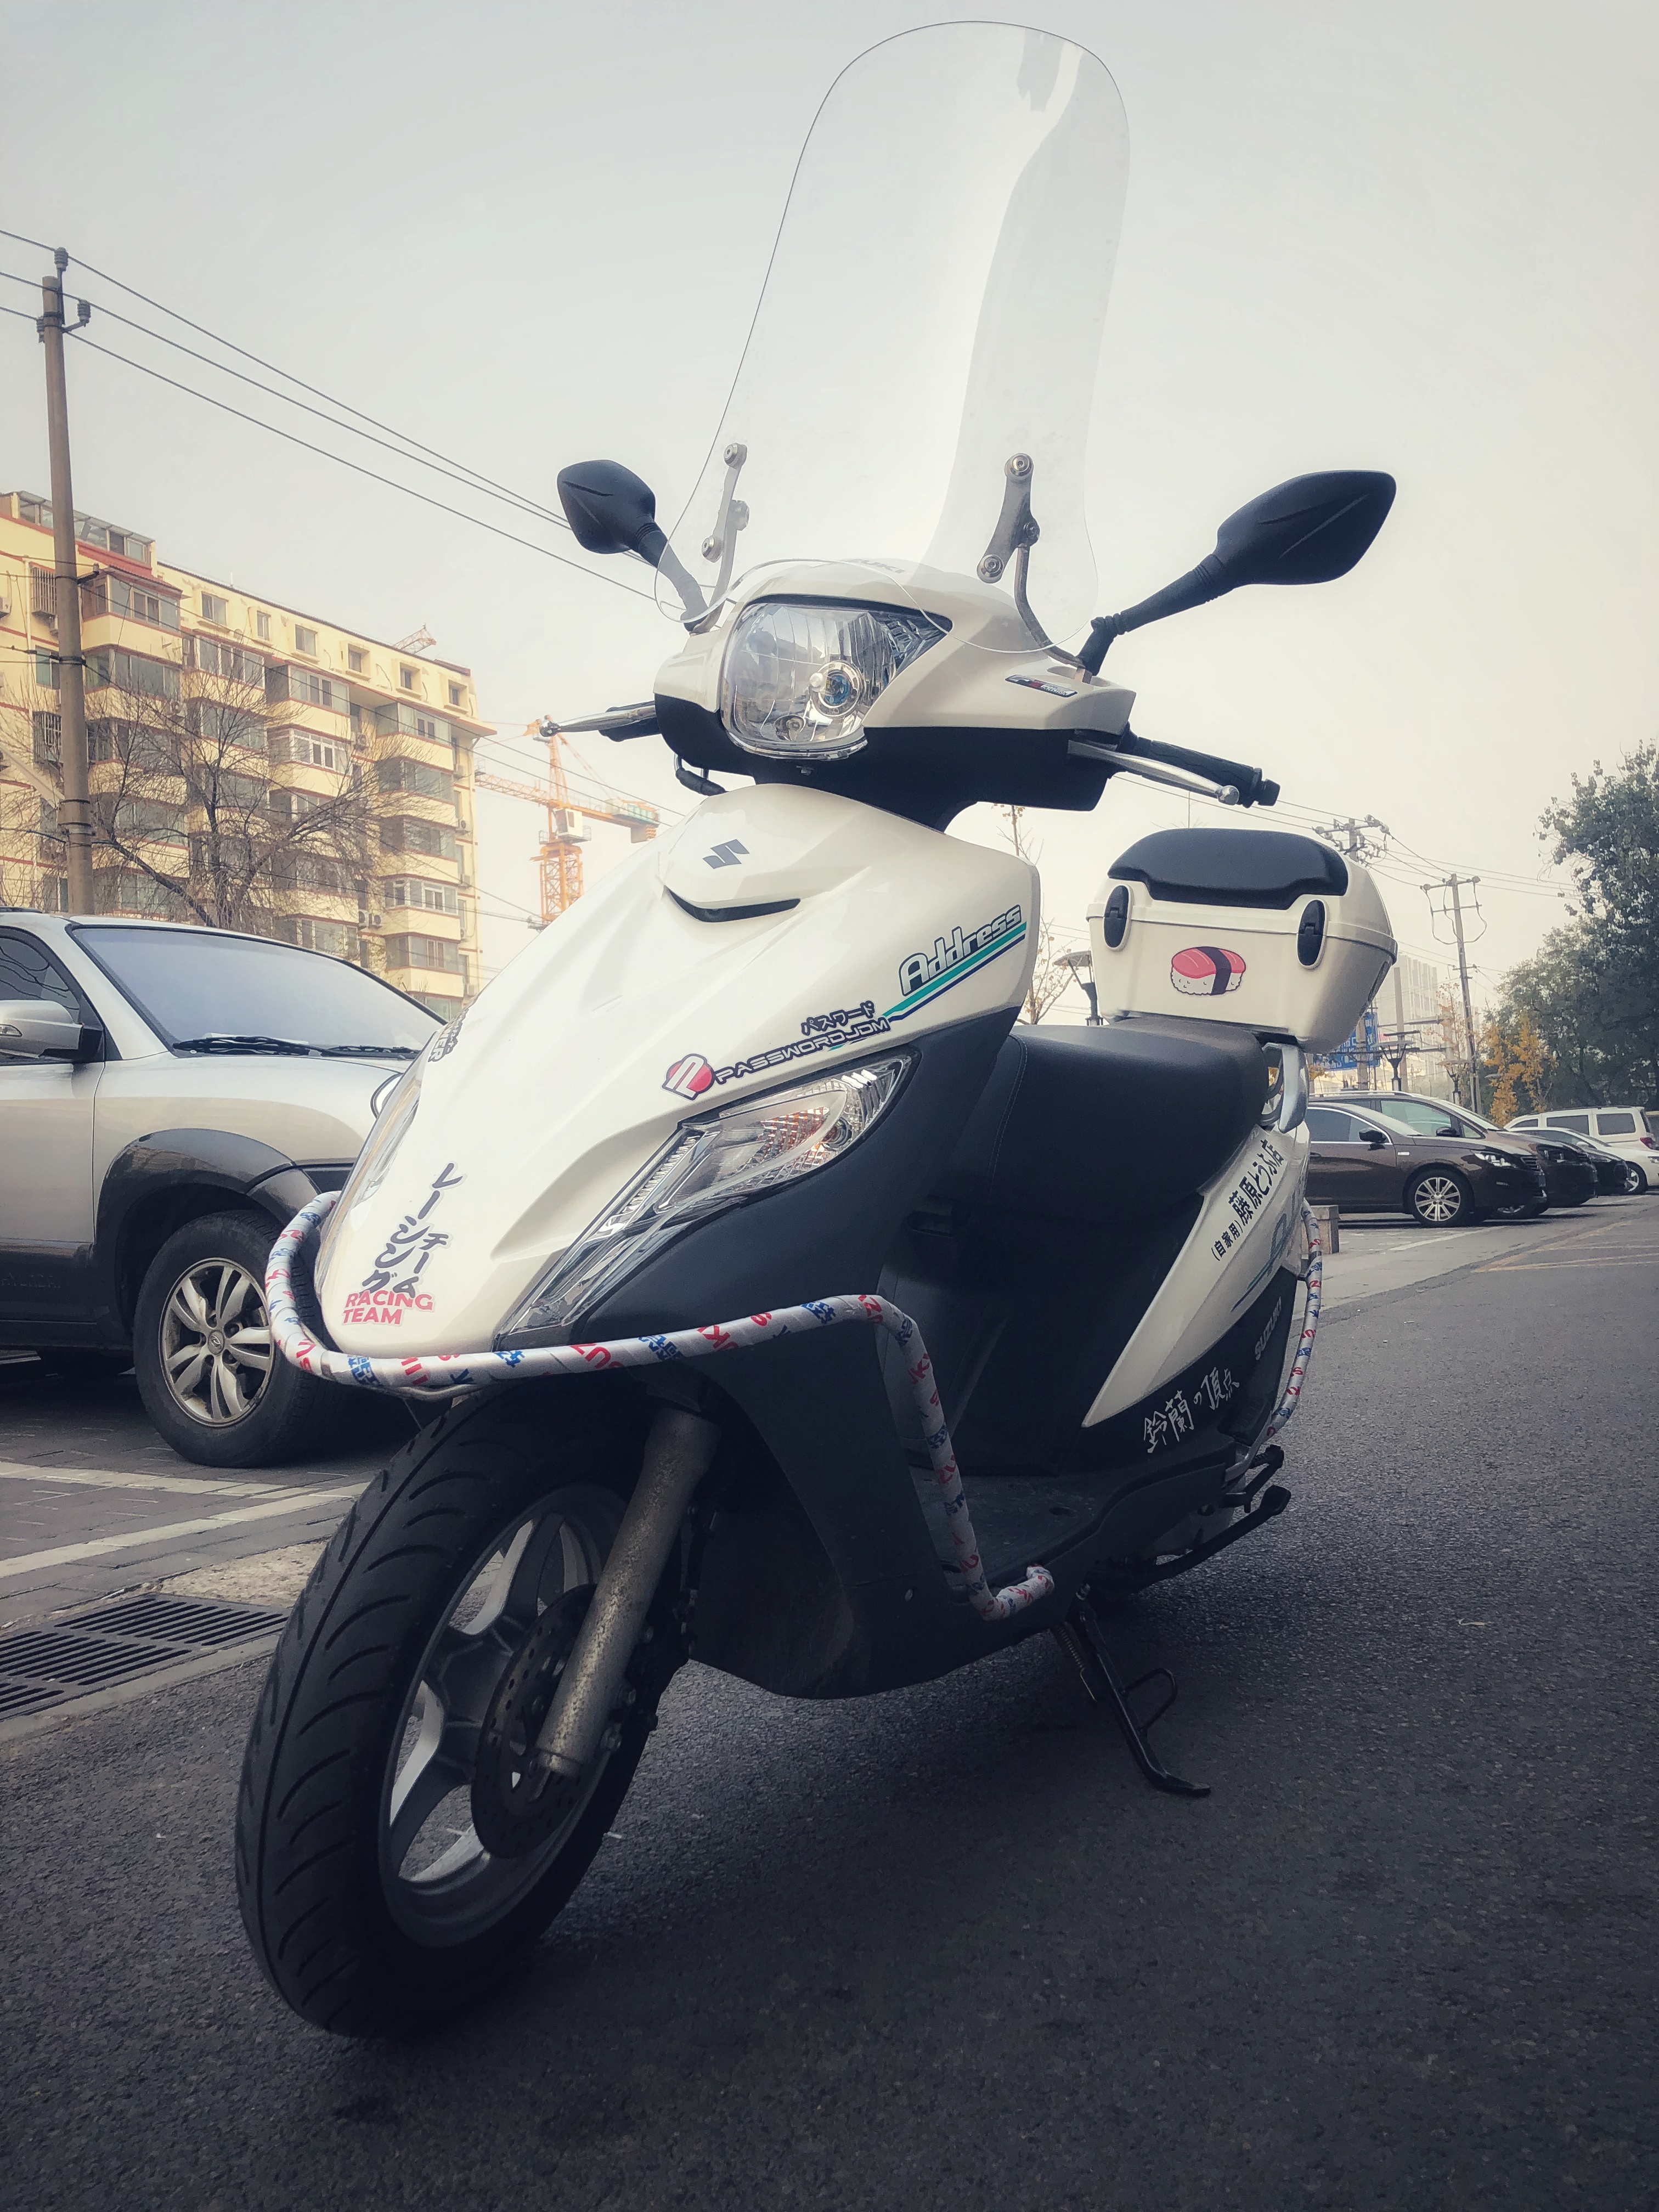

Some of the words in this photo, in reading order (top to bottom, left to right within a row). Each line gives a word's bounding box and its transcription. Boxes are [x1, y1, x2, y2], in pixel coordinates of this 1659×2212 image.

[899, 905, 1022, 996] Address
[803, 1001, 874, 1035] パスワード
[345, 1290, 433, 1310] RACING
[343, 1307, 403, 1325] TEAM
